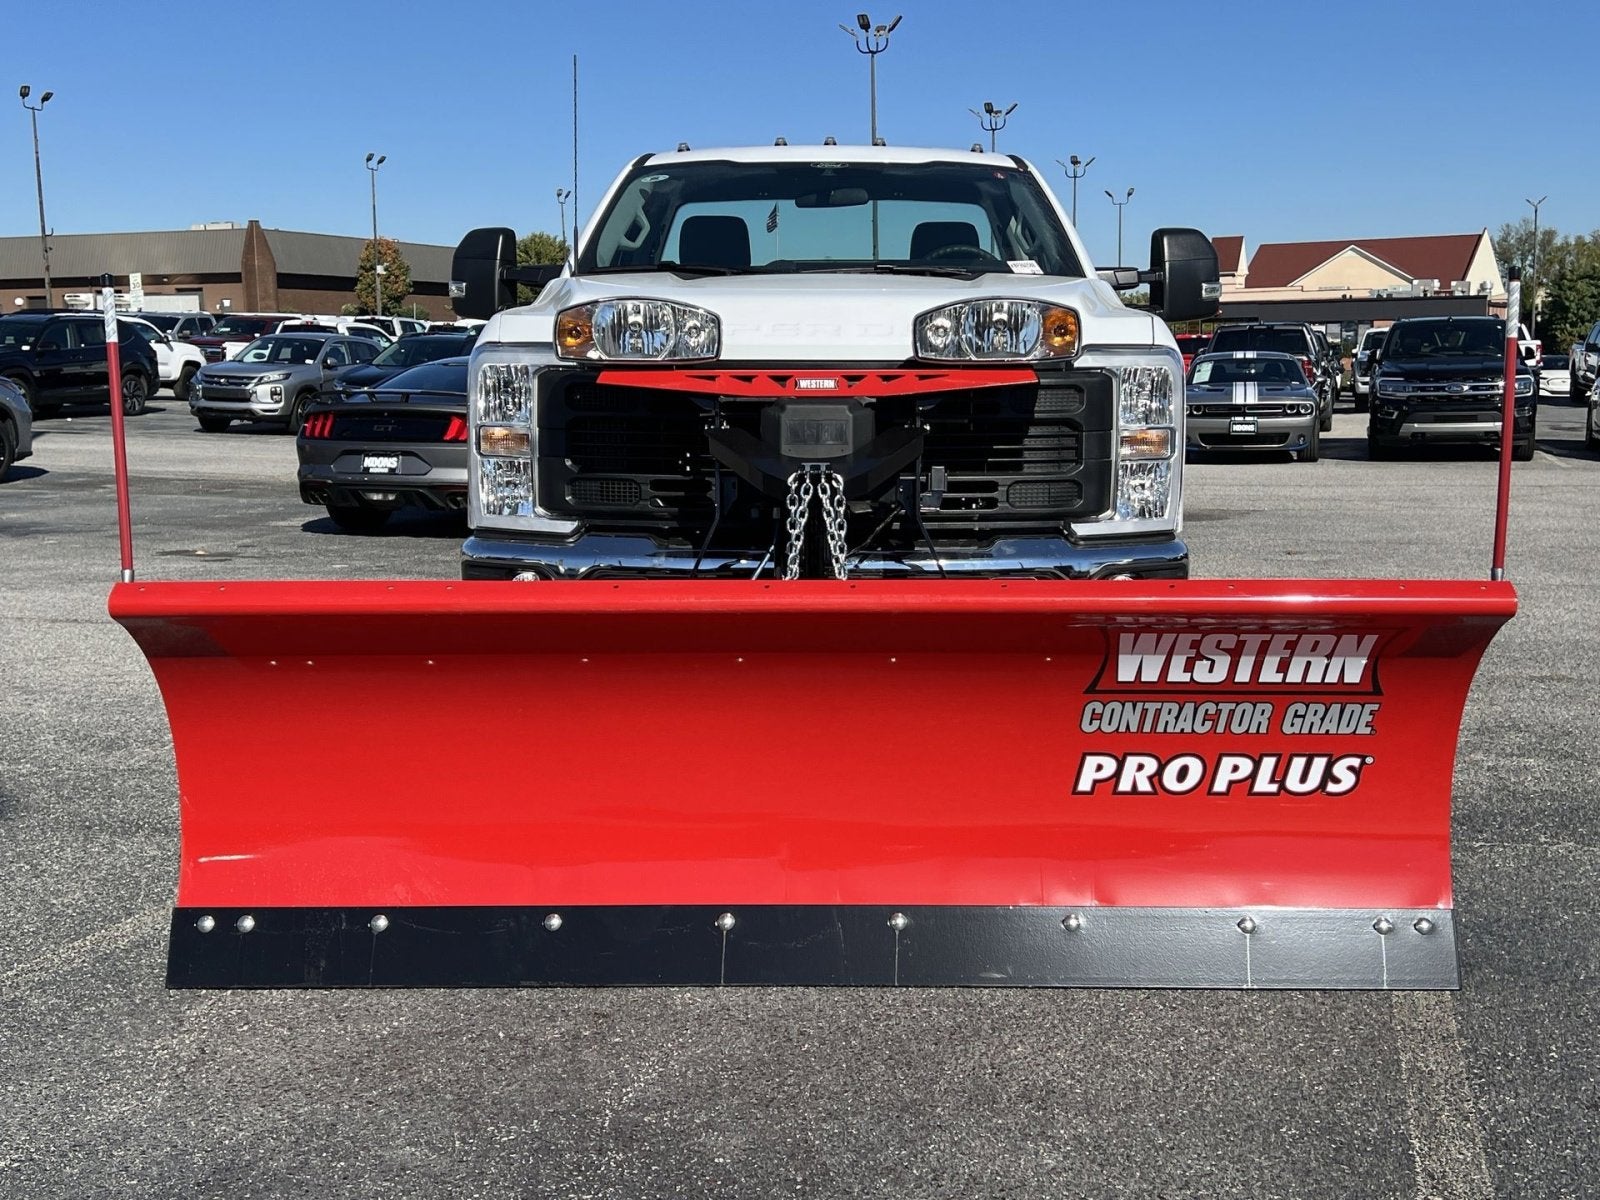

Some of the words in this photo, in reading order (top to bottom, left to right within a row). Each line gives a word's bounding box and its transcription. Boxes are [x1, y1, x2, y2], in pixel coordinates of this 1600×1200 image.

[799, 379, 836, 389] WESTERN
[1116, 632, 1380, 684] WESTERN
[1080, 701, 1274, 734] CONTRACTOR
[1281, 702, 1380, 735] GRADE
[1074, 753, 1207, 795] PRO
